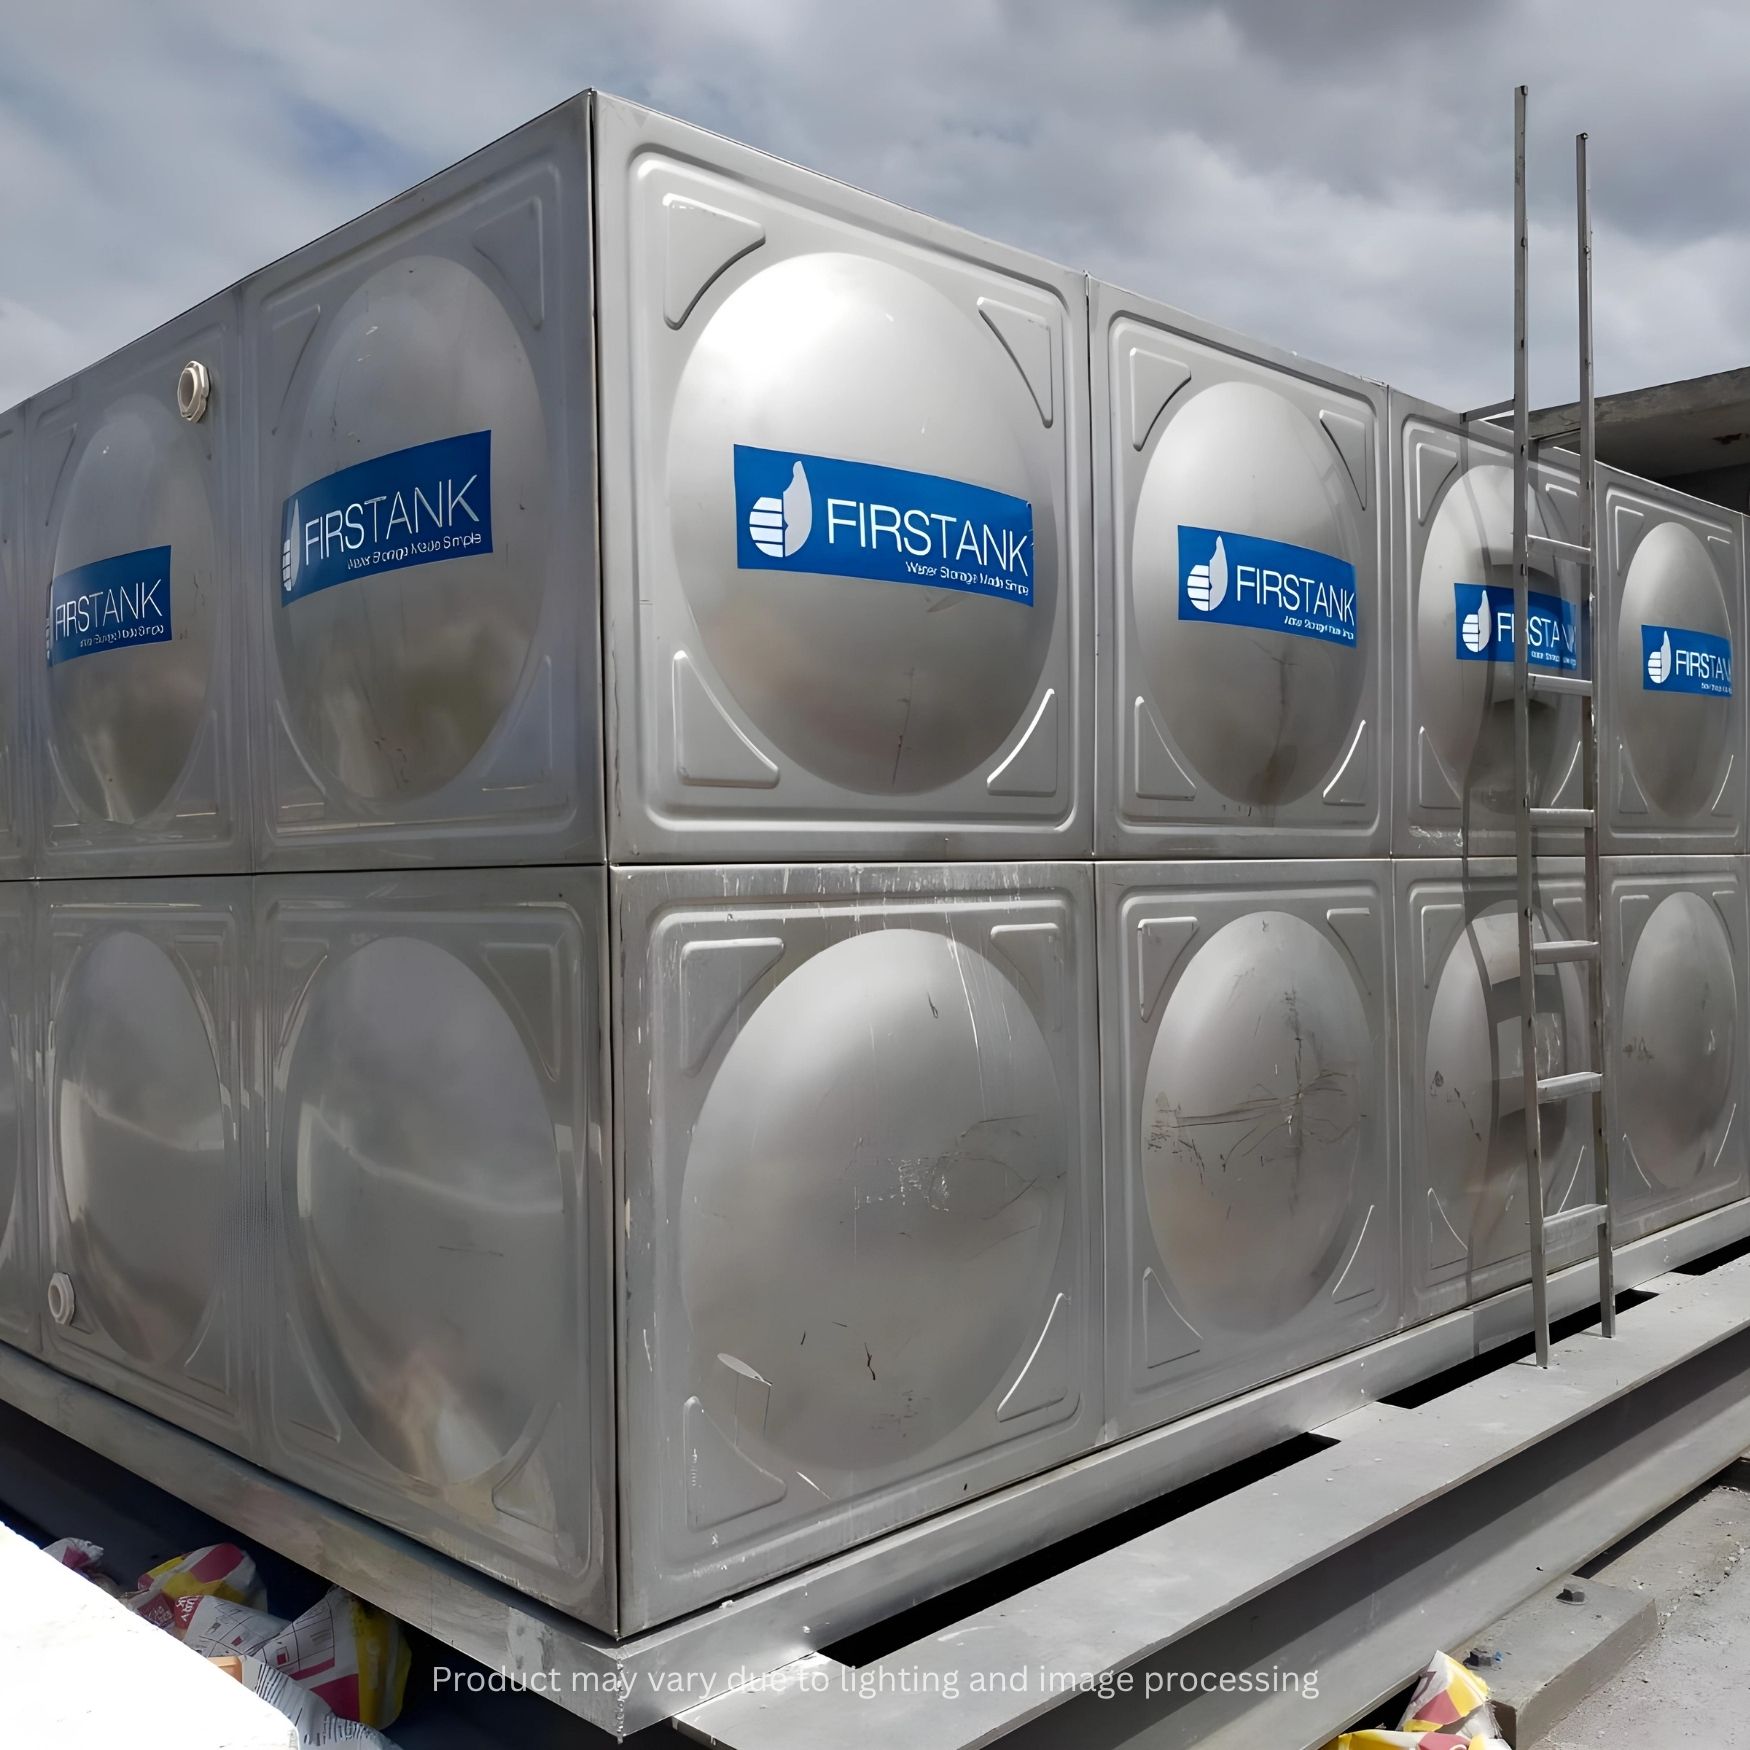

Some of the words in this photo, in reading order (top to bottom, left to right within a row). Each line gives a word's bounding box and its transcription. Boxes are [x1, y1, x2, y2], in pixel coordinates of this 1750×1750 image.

[305, 474, 478, 566] FIRSTANK
[827, 498, 1029, 577] FIRSTANK
[1236, 565, 1355, 627] FIRSTANK
